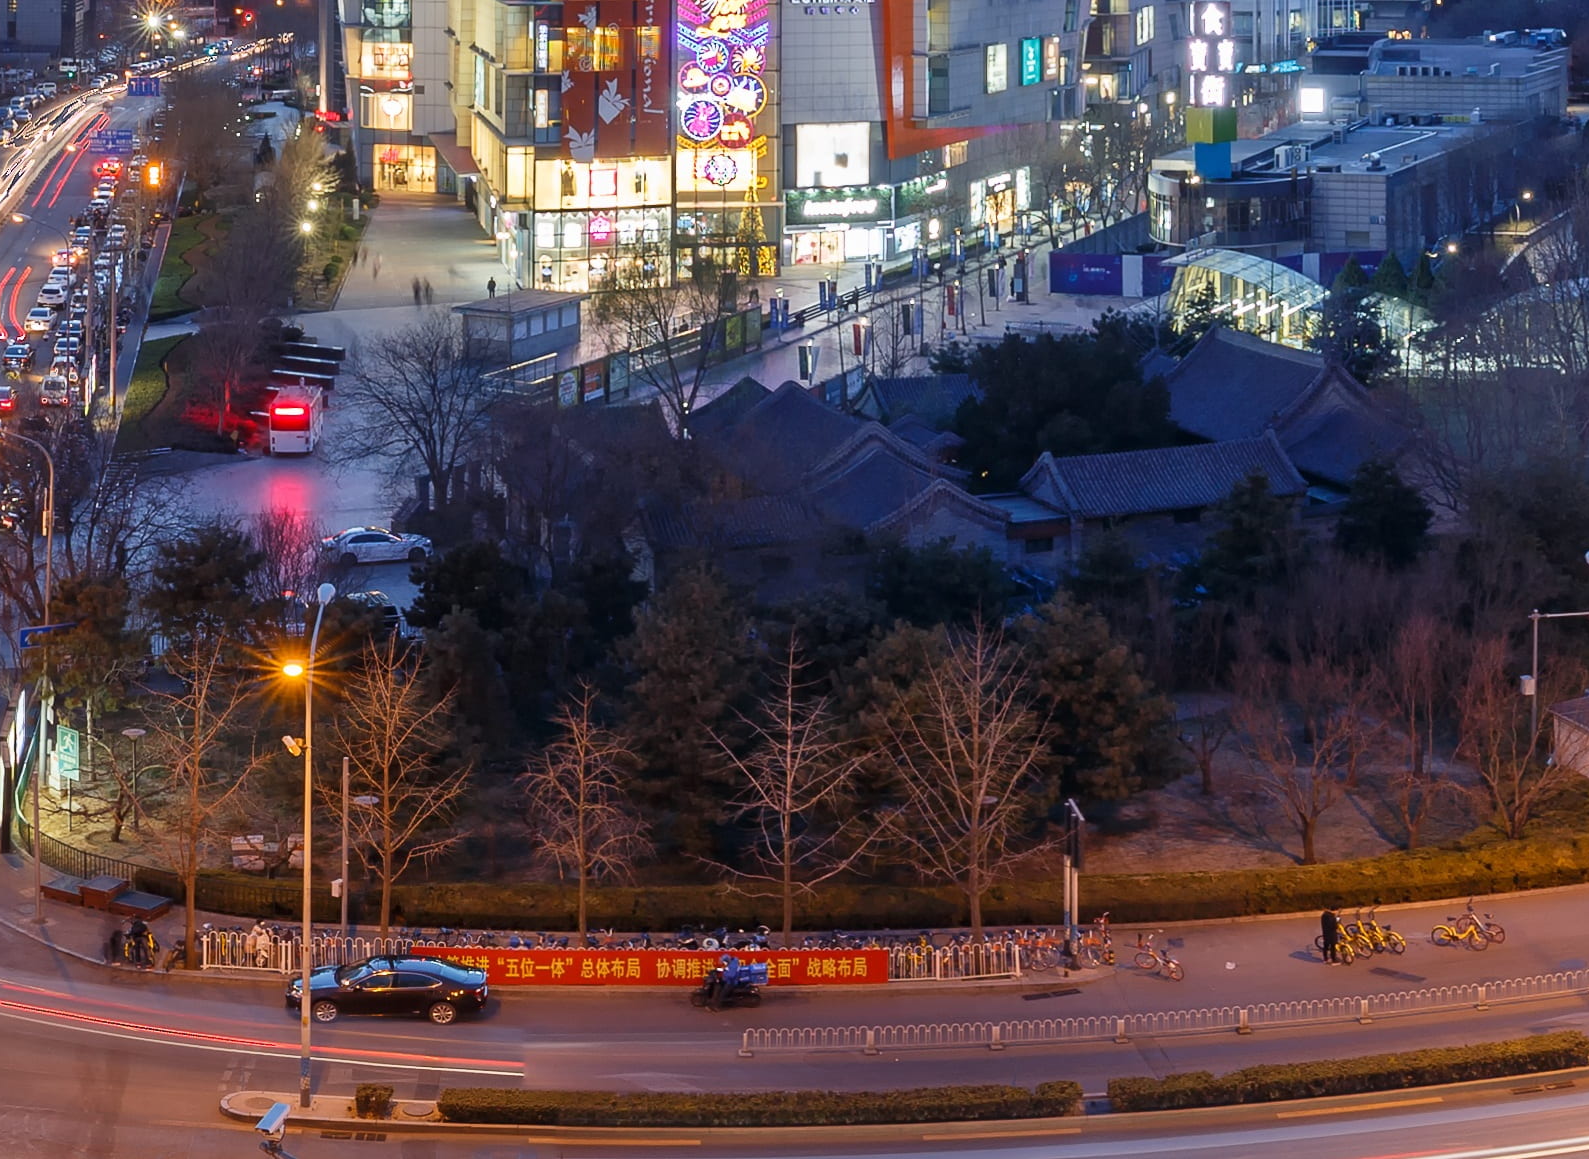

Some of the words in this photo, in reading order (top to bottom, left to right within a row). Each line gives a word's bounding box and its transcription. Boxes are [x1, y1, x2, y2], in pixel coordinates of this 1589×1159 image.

[581, 957, 641, 979] 总体布局
[807, 957, 868, 979] 战略布局
